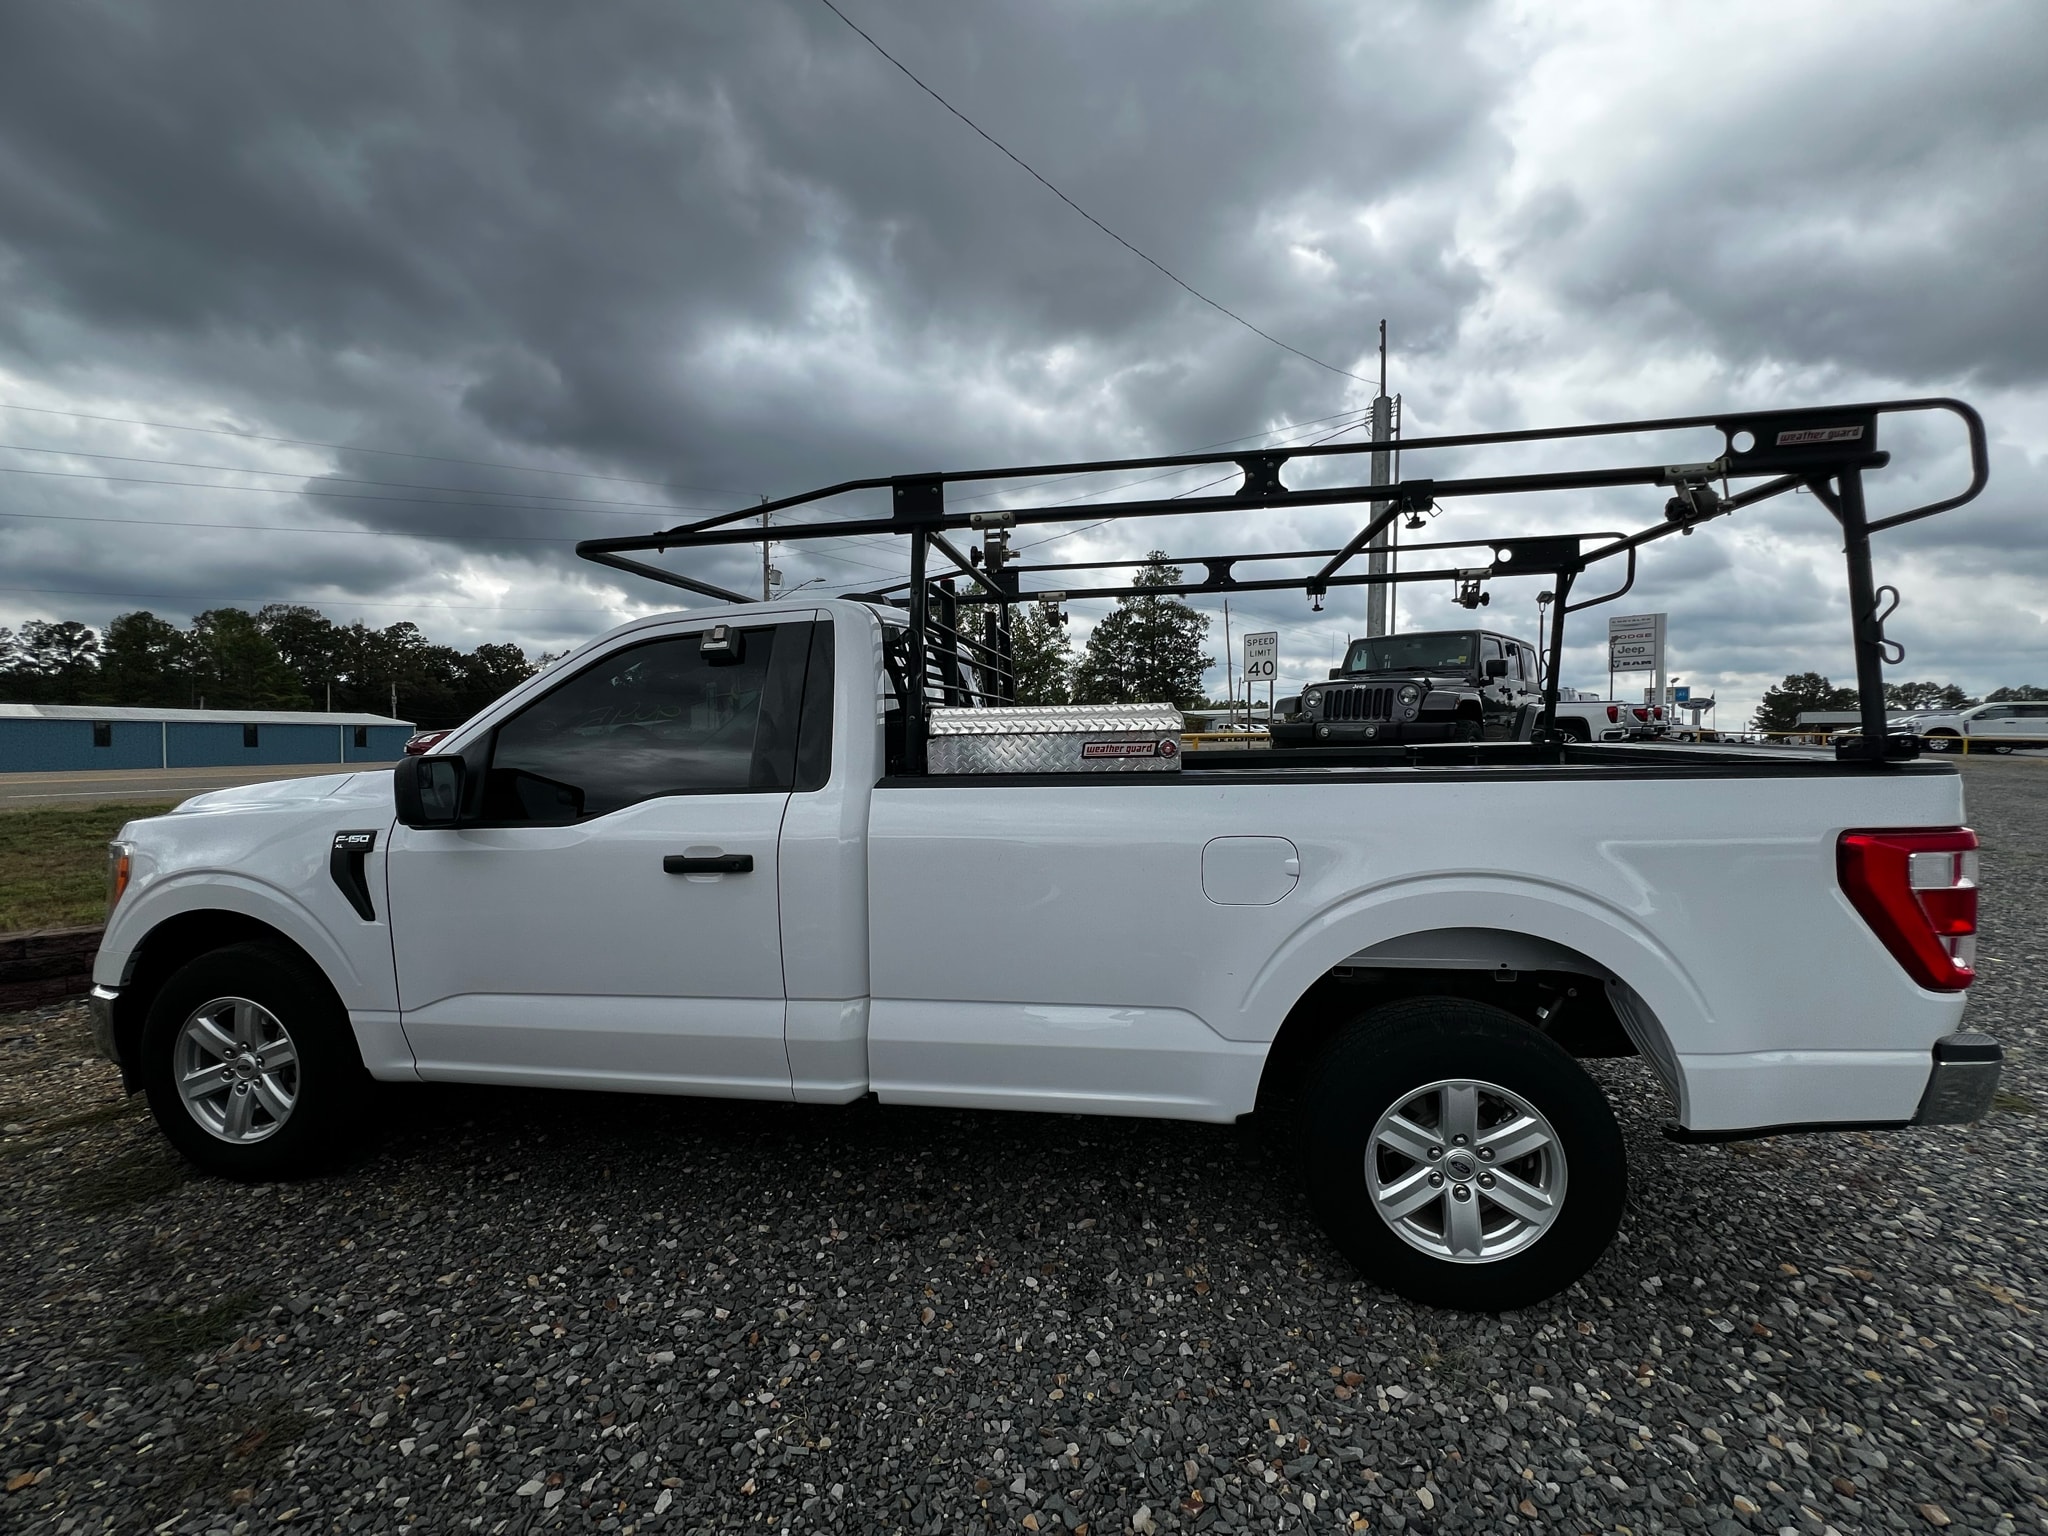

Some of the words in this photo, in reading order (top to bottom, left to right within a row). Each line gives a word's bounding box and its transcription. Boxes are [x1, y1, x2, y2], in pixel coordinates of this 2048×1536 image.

[1779, 431, 1825, 442] weather
[1828, 427, 1860, 439] guard
[1246, 637, 1275, 647] SPEED
[1249, 649, 1272, 658] LIMIT
[1617, 646, 1646, 655] Jeep
[1247, 660, 1274, 676] 40
[1086, 744, 1123, 754] weather
[1126, 743, 1153, 753] guard
[335, 834, 370, 843] F-150
